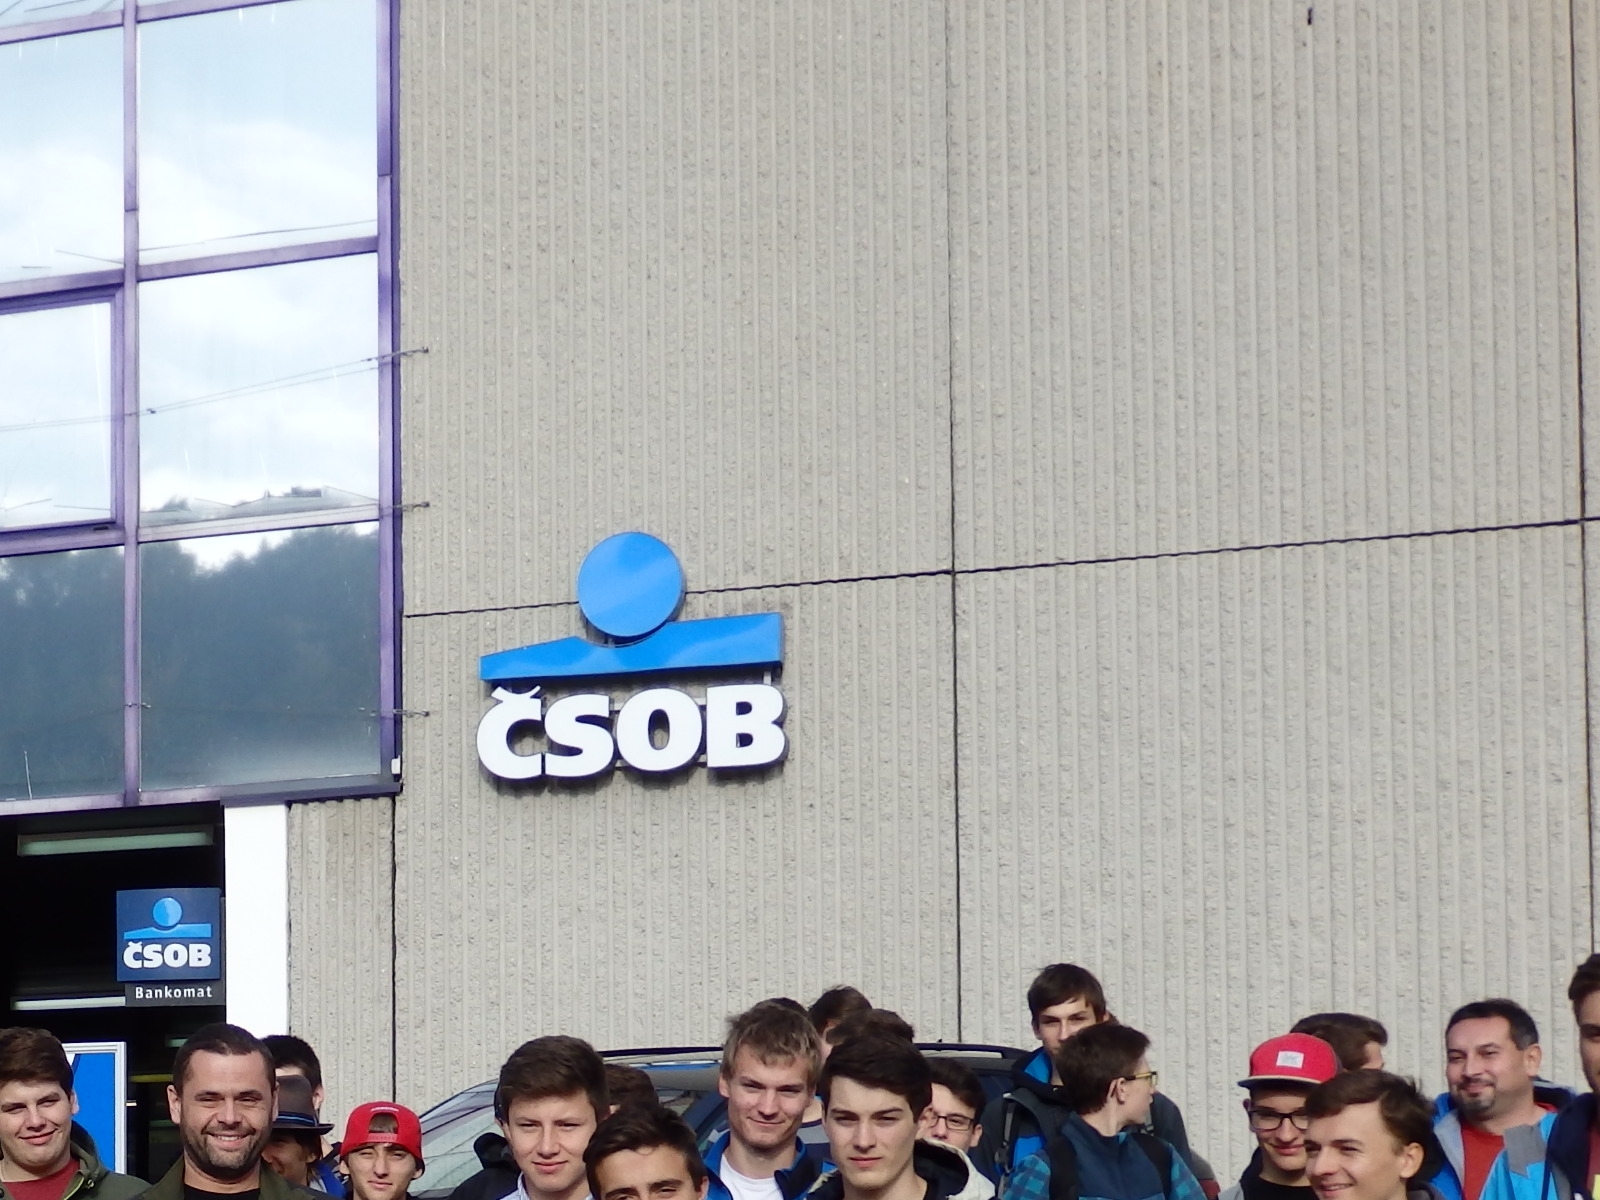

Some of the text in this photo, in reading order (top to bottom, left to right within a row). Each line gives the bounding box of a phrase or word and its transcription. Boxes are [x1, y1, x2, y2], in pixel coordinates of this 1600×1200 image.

[477, 684, 786, 780] ČSOB
[123, 941, 212, 969] ČSOB
[135, 986, 213, 999] Bankomat
